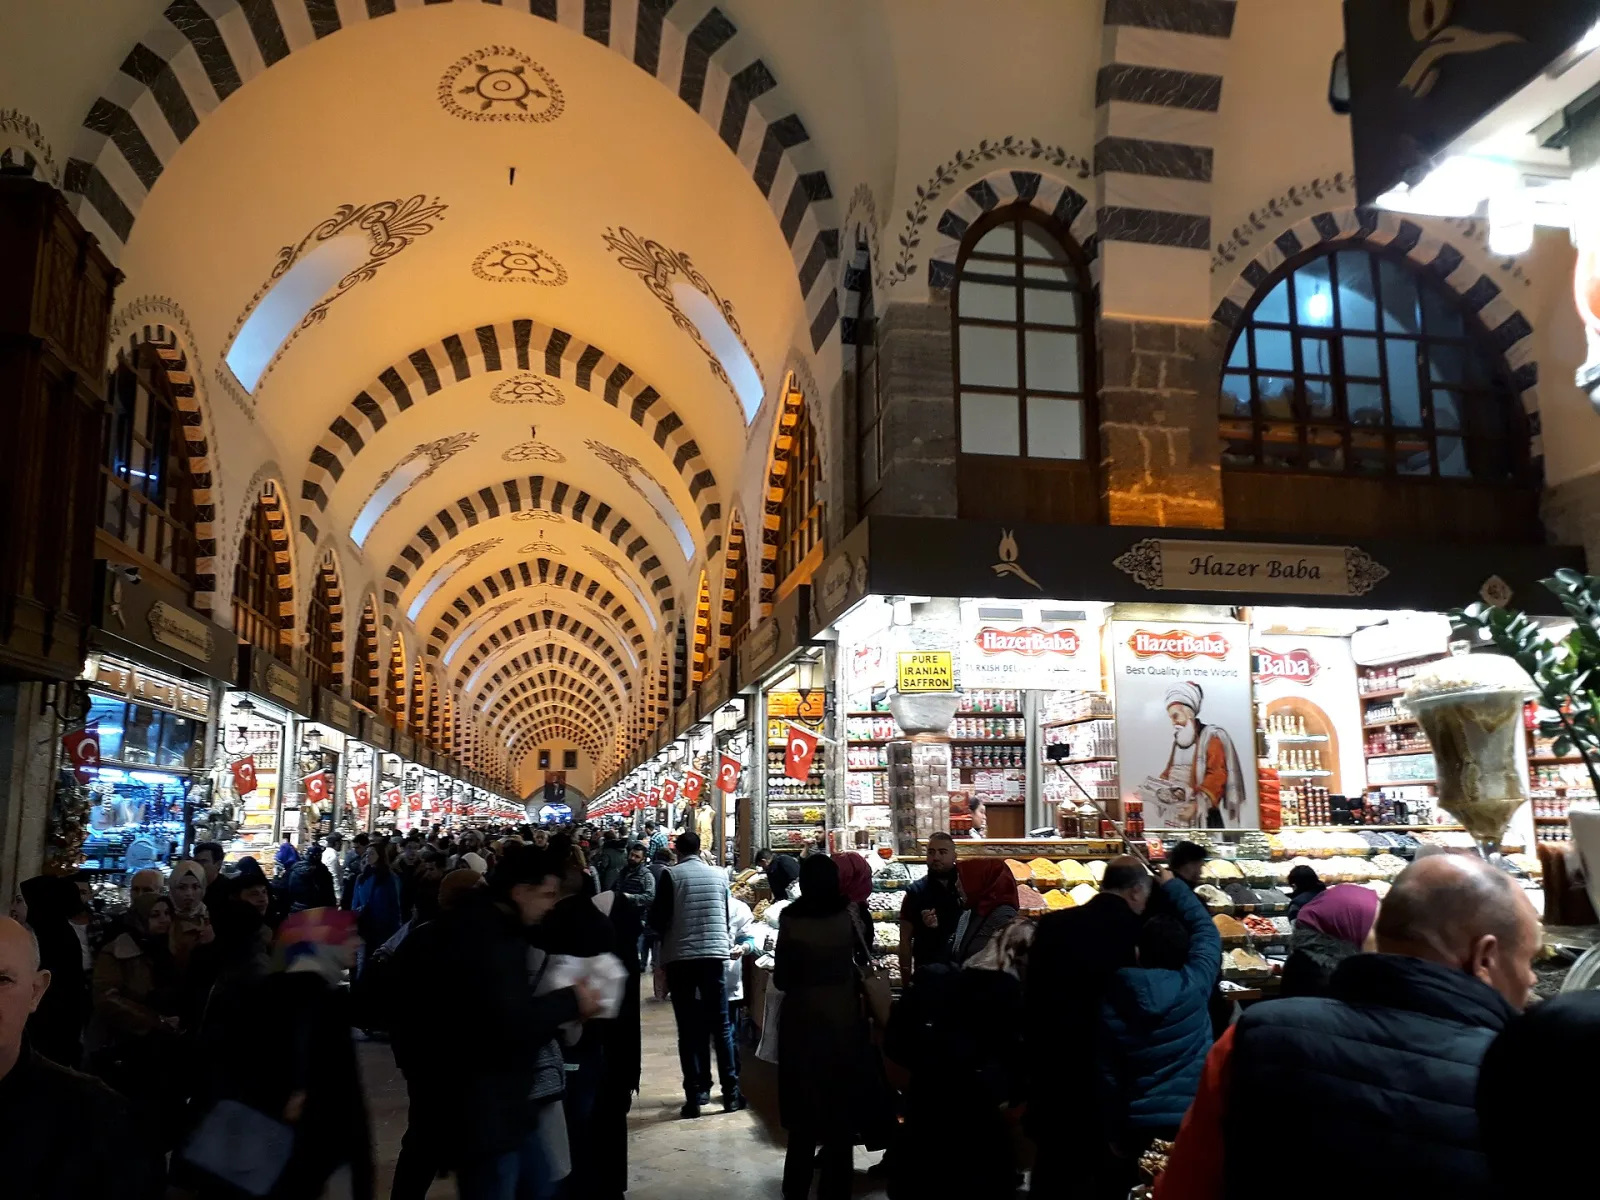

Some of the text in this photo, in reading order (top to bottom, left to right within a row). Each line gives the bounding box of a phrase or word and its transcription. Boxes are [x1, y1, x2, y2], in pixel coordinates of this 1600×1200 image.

[1188, 555, 1321, 579] Hazer Baba
[1136, 634, 1225, 653] HazerBaba
[912, 655, 938, 664] PURE
[904, 667, 947, 676] IRANIAN
[1126, 665, 1146, 675] Best
[1147, 666, 1180, 677] Quality
[1182, 667, 1192, 676] in
[1193, 668, 1208, 677] the
[903, 678, 949, 688] SAFFRON
